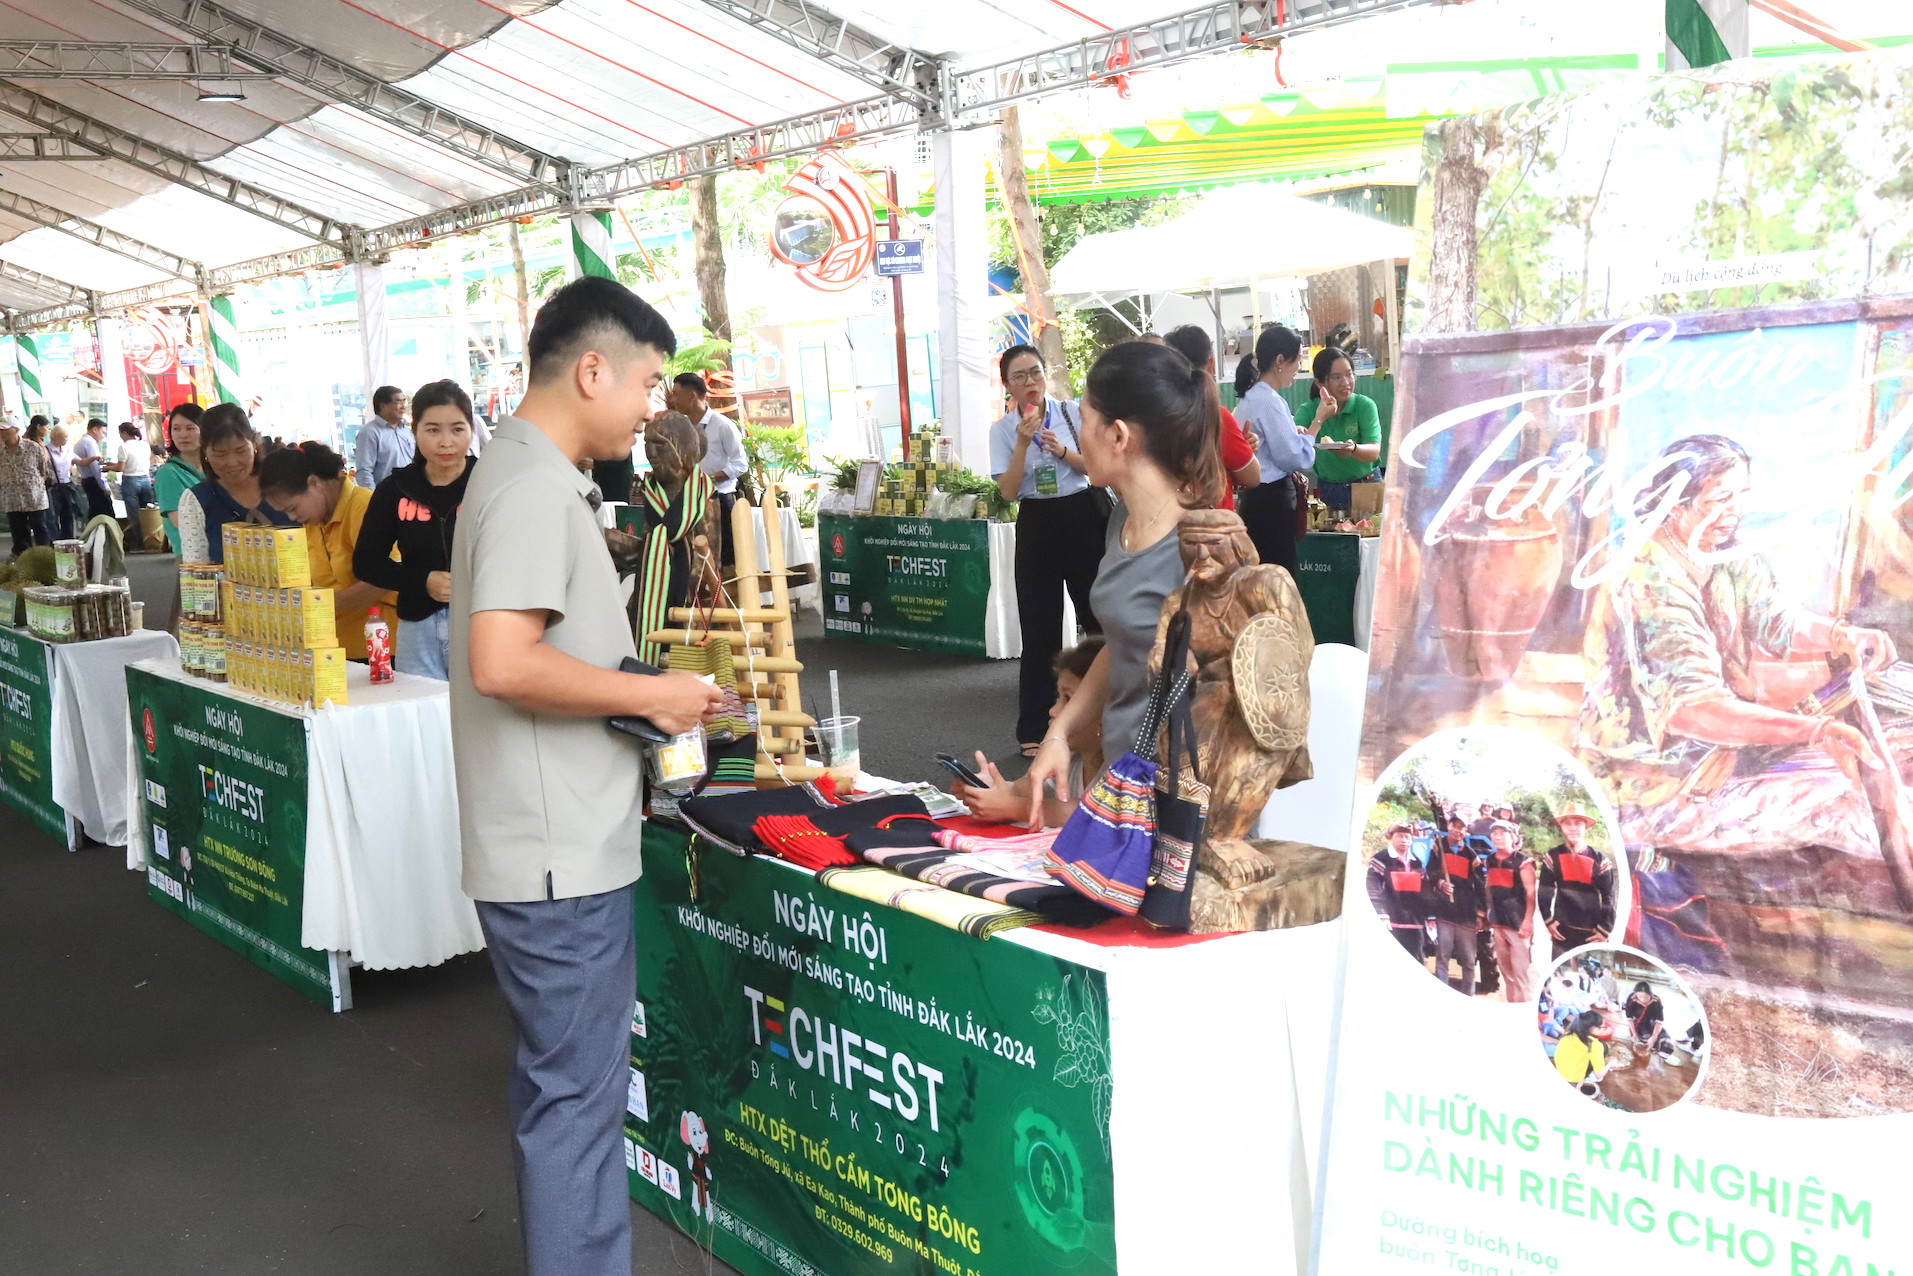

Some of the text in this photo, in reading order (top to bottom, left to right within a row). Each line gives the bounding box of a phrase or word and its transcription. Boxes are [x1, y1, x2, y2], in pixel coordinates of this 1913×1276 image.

[1661, 272, 1680, 285] Du
[897, 521, 932, 539] NGÀY HỘI
[959, 543, 970, 551] 2024
[886, 555, 947, 577] TECHFEST
[1314, 563, 1331, 572] 2024
[205, 704, 243, 742] NGÀY HỘI
[198, 763, 264, 824] TECHFEST
[275, 761, 288, 778] 2024
[773, 889, 887, 970] NGÀY HỘI
[678, 905, 1036, 1070] KHỞI NGHIỆP ĐỔI MỚI SÁNG TẠO TỈNH ĐẮK LẮK 2024
[743, 985, 944, 1133] TECHFEST
[740, 1102, 981, 1254] HTX DỆT THỔ CẨM TƠNG BÔNG
[875, 1121, 950, 1178] 2024
[1385, 1090, 1872, 1239] NHỮNG TRẢI NGHIỆM
[724, 1128, 739, 1147] ĐC:
[740, 1136, 760, 1159] Buôn
[795, 1170, 805, 1186] xã
[805, 1176, 817, 1193] Ea
[818, 1183, 838, 1207] Kao,
[839, 1194, 866, 1222] Thành
[867, 1214, 886, 1234] phố
[887, 1223, 913, 1250] Buôn
[914, 1239, 929, 1259] Ma
[1383, 1135, 1504, 1196] DÀNH
[1519, 1172, 1656, 1233] RIÊNG
[1667, 1210, 1776, 1268] CHO
[815, 1205, 893, 1263] ĐT: 0329.602.969
[1379, 1236, 1435, 1264] buôn
[1380, 1210, 1559, 1274] Đường bích hoạ
